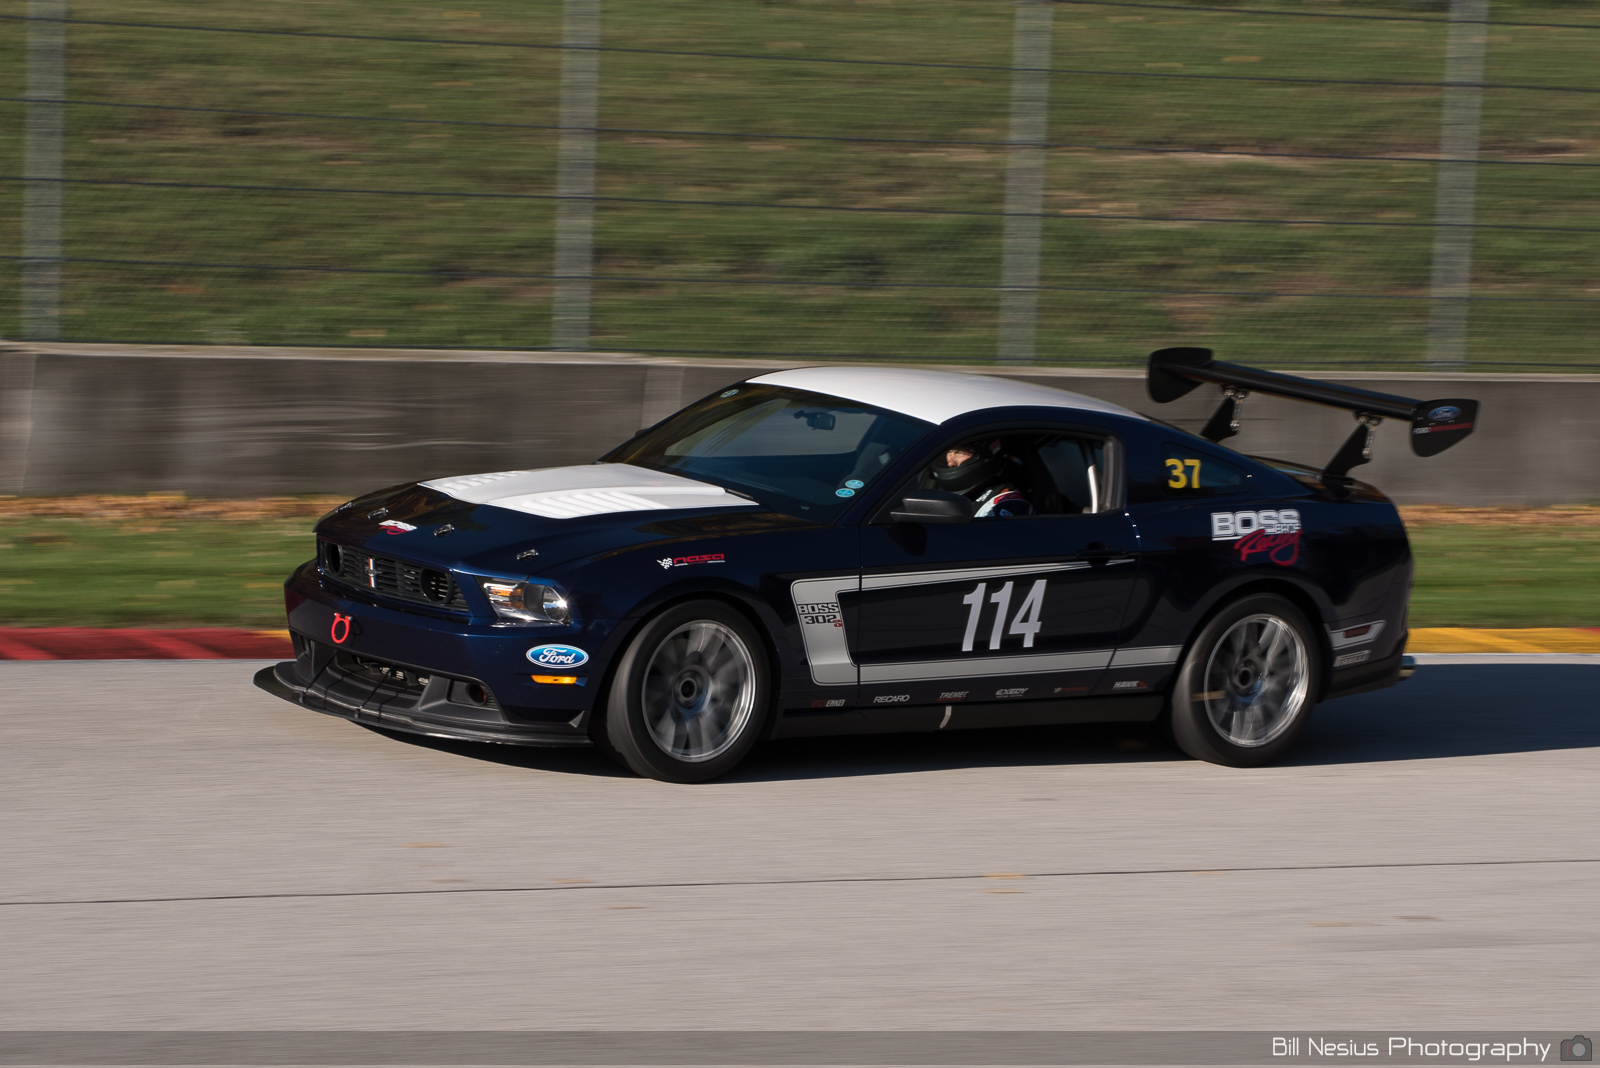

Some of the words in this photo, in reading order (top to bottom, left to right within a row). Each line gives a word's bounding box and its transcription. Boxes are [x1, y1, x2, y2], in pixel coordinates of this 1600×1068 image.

[1164, 458, 1202, 489] 37
[1211, 509, 1301, 537] BOSS
[673, 553, 725, 564] nasa
[797, 603, 840, 614] BOSS
[961, 579, 1047, 652] 114
[538, 647, 577, 664] Ford
[939, 691, 969, 699] TREMEC
[995, 687, 1029, 696] EXEDY
[873, 694, 910, 703] RECARO
